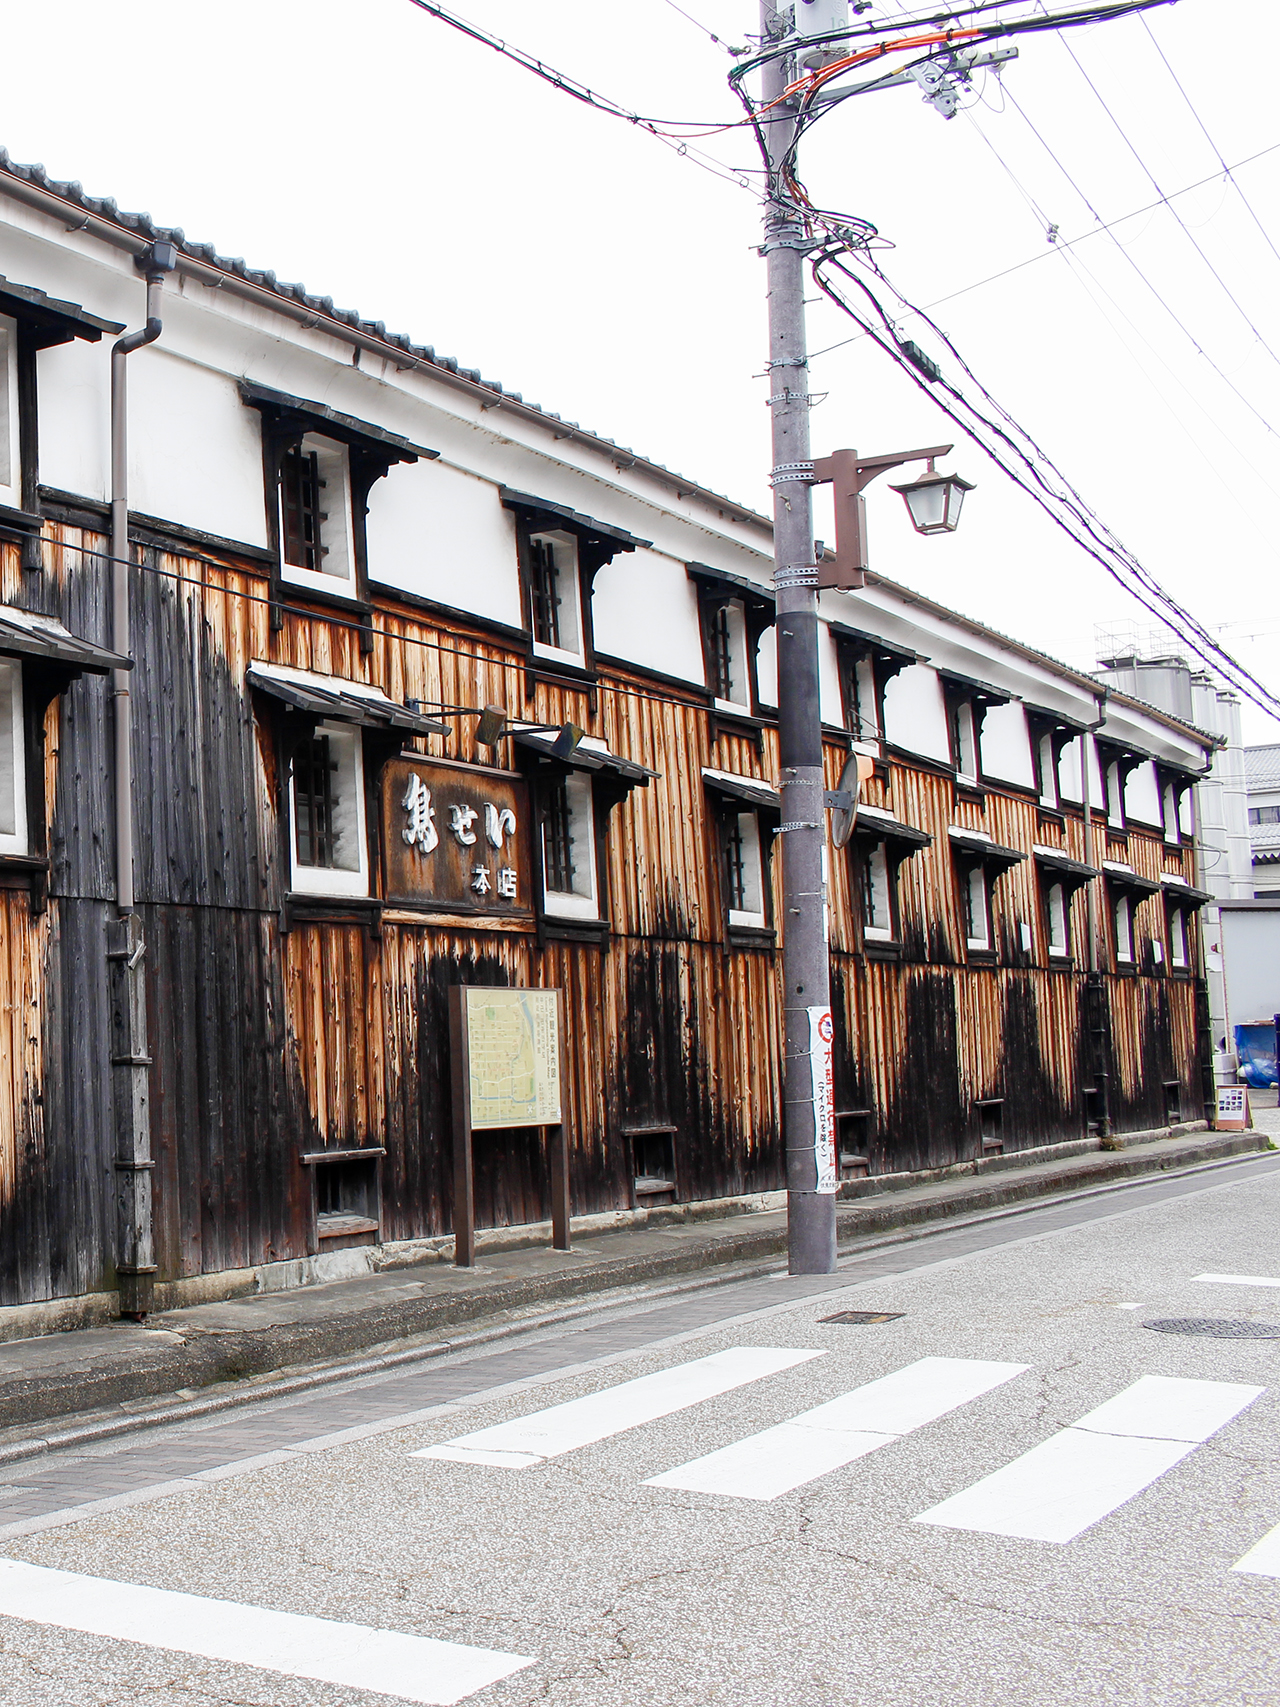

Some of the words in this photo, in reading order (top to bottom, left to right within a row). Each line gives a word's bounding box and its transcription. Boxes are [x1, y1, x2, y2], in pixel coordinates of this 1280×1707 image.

[402, 772, 516, 854] 鳥せい
[471, 864, 517, 898] 本店
